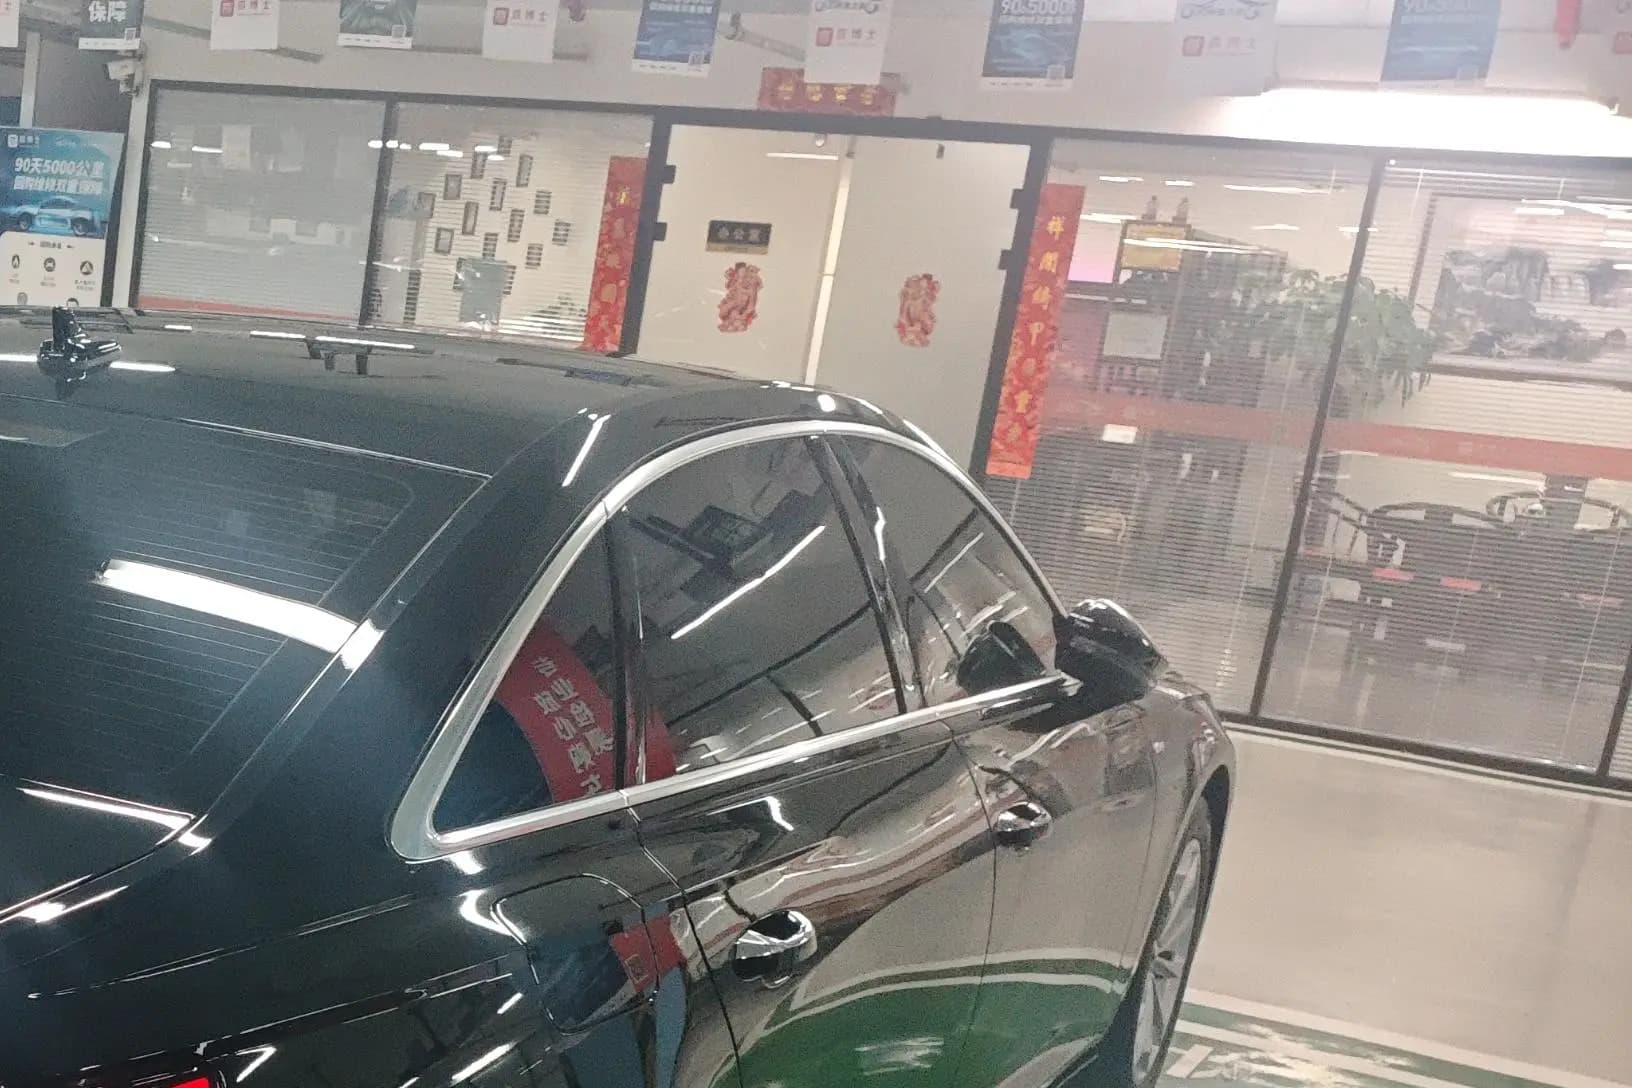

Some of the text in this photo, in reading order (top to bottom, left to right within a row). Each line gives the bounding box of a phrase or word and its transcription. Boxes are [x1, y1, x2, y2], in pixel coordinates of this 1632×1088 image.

[88, 0, 128, 23] 保障
[15, 157, 104, 178] 90天5000公里
